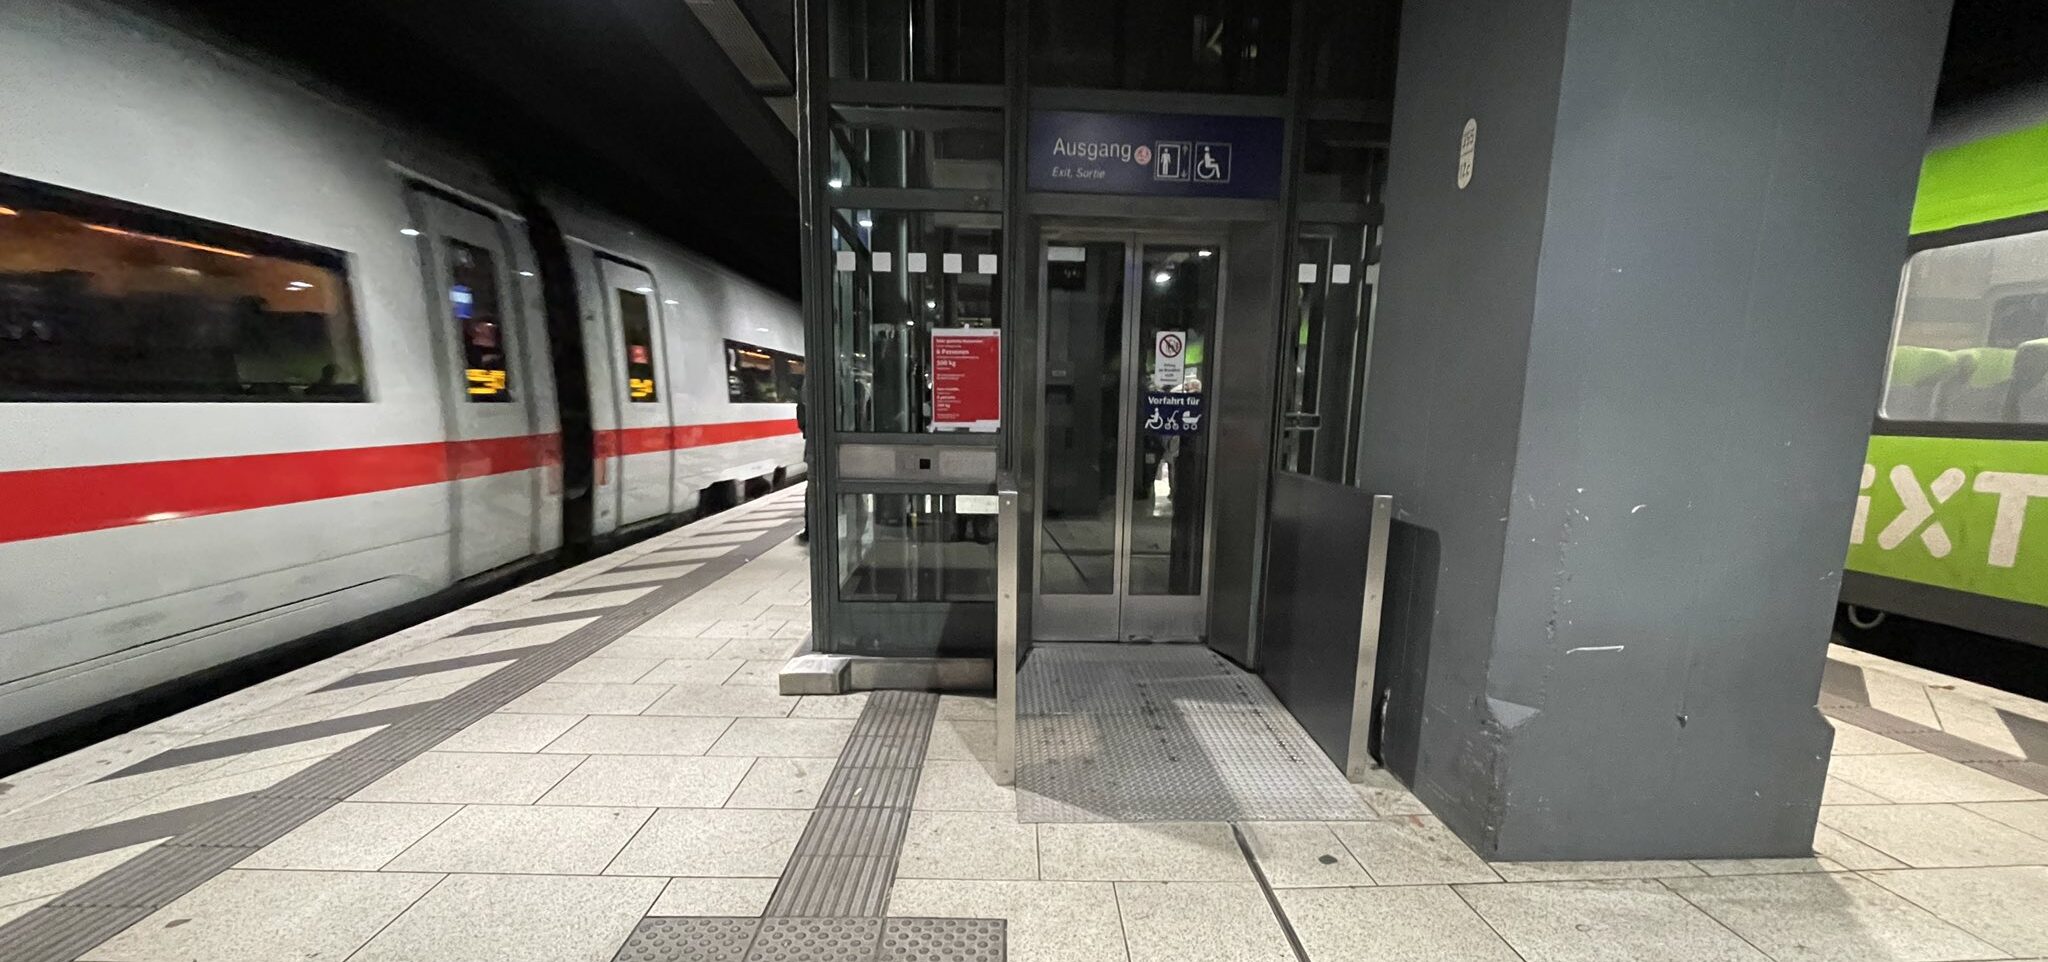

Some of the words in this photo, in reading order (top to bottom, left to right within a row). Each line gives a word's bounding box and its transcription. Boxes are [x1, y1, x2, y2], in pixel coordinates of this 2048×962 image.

[1053, 137, 1131, 162] Ausgang
[1076, 167, 1105, 179] Sortie
[1148, 396, 1184, 405] Vorfahrt
[1187, 396, 1200, 405] für
